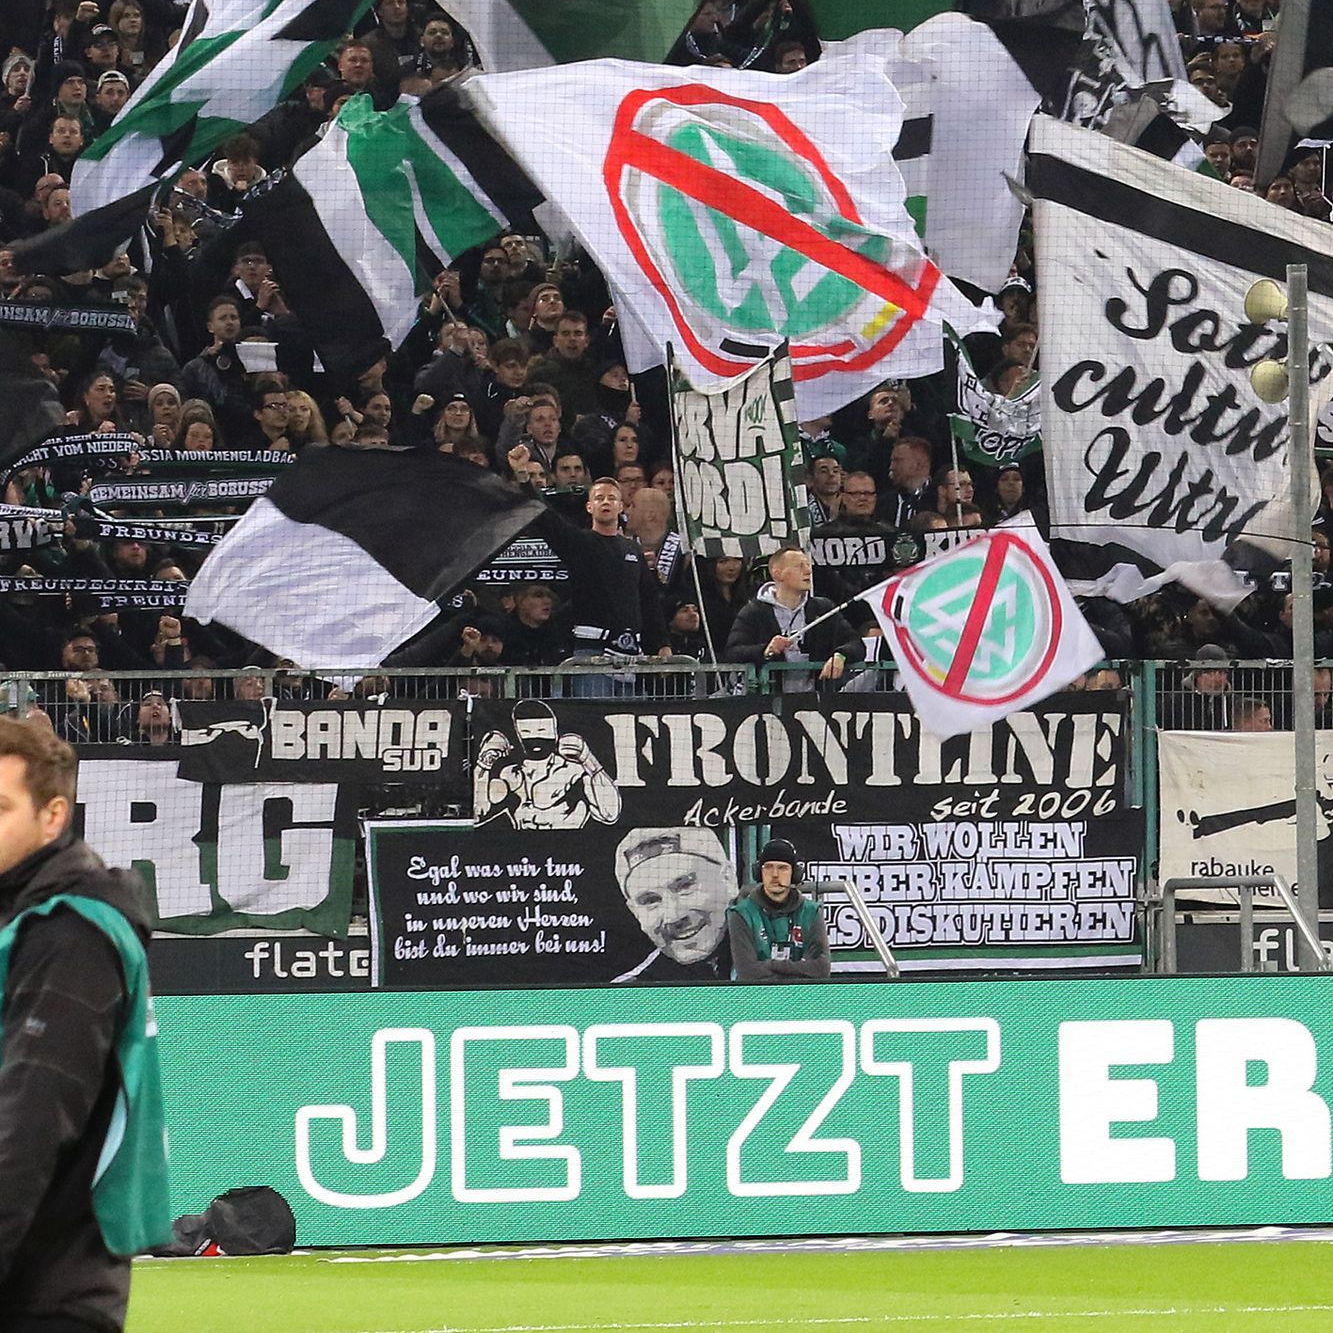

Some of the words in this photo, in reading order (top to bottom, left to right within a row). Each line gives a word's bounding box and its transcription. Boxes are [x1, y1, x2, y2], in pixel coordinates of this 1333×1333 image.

[53, 441, 87, 456] VOM
[90, 484, 183, 503] GEMEINSAM
[271, 709, 452, 760] BANDA
[602, 710, 1123, 788] FRONTLINE
[381, 748, 443, 772] SUD
[683, 788, 849, 827] Ackerbande
[928, 791, 1002, 819] seit
[1013, 787, 1118, 818] 2006
[832, 823, 917, 862] WIR
[923, 821, 1083, 860] WOLLEN
[407, 856, 462, 885] Egal
[464, 862, 503, 879] was
[506, 857, 541, 878] wir
[545, 858, 584, 877] tun
[940, 856, 1133, 902] KÄMPFEN
[1189, 858, 1276, 881] rabauke
[417, 882, 461, 906] und
[463, 888, 494, 904] wo
[496, 883, 531, 904] wir
[404, 913, 428, 933] in
[430, 913, 512, 935] unseren
[515, 904, 594, 933] Herzen
[864, 902, 1134, 946] DISKUTIEREN
[395, 933, 430, 960] bist
[433, 936, 461, 959] du
[464, 933, 531, 957] immer
[533, 929, 562, 955] bei
[562, 929, 607, 956] uns!
[295, 1016, 1001, 1210] JETZT
